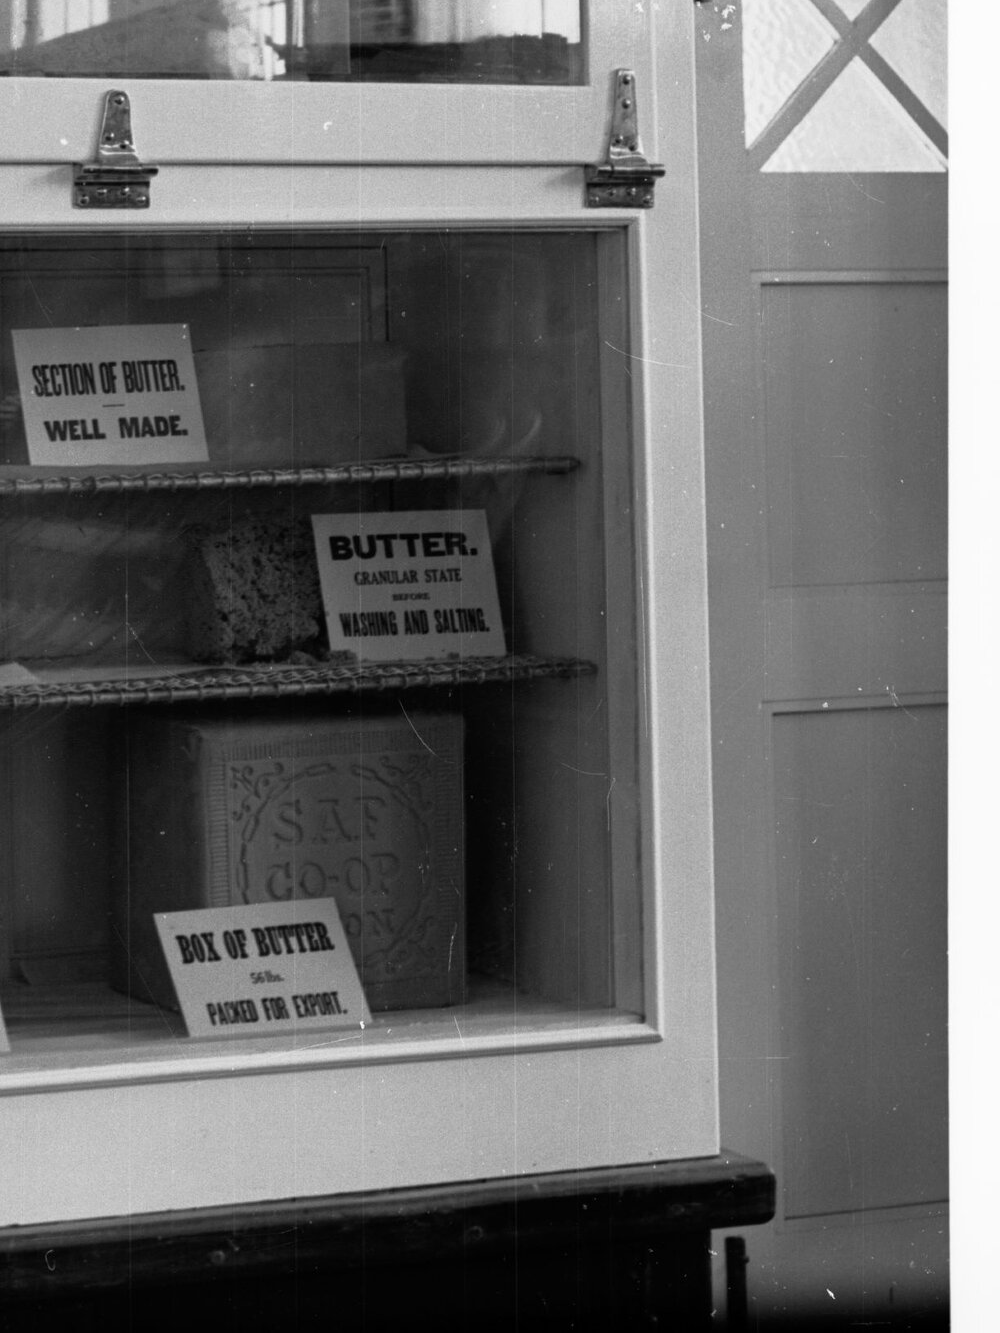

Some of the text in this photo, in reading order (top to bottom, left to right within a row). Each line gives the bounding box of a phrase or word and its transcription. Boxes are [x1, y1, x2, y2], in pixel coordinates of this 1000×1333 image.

[32, 359, 185, 397] SECTION OF BUTTER.
[44, 415, 189, 442] WELL MADE.
[329, 532, 478, 561] BUTTER.
[354, 568, 462, 586] GRANULAR STATE
[392, 592, 430, 601] BEFORE
[339, 608, 490, 638] WASHING AND SALTING.
[175, 921, 335, 964] BOX OF BUTTER
[206, 991, 348, 1026] PACKED FOR EXPORT.
